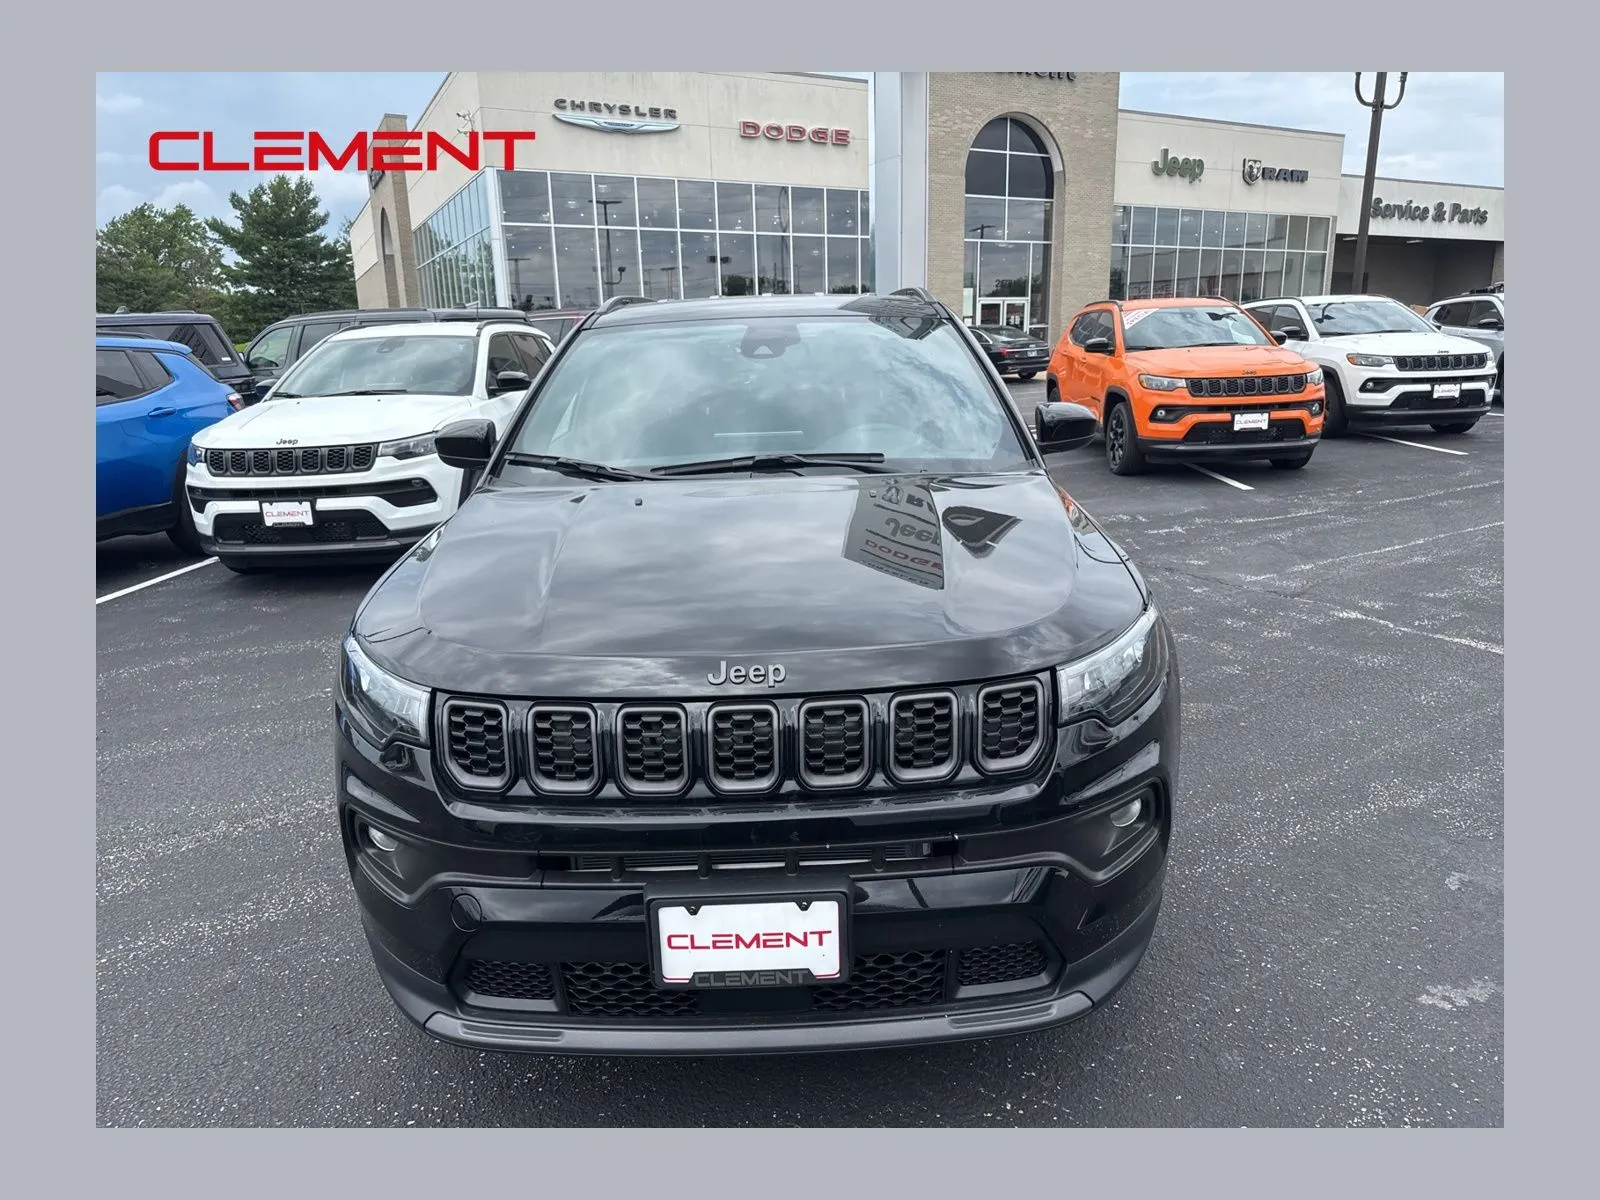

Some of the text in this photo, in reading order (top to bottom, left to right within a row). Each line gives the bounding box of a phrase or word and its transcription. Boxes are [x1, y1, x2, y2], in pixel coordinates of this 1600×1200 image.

[553, 98, 677, 120] CHRYSLER
[739, 119, 850, 145] DODGE
[1151, 147, 1205, 184] Jeep
[1261, 166, 1309, 183] RAM
[1370, 197, 1488, 226] Service & Parts
[707, 660, 786, 688] Jeep
[667, 930, 832, 950] CLEMENT
[695, 970, 808, 987] CLEMENT
